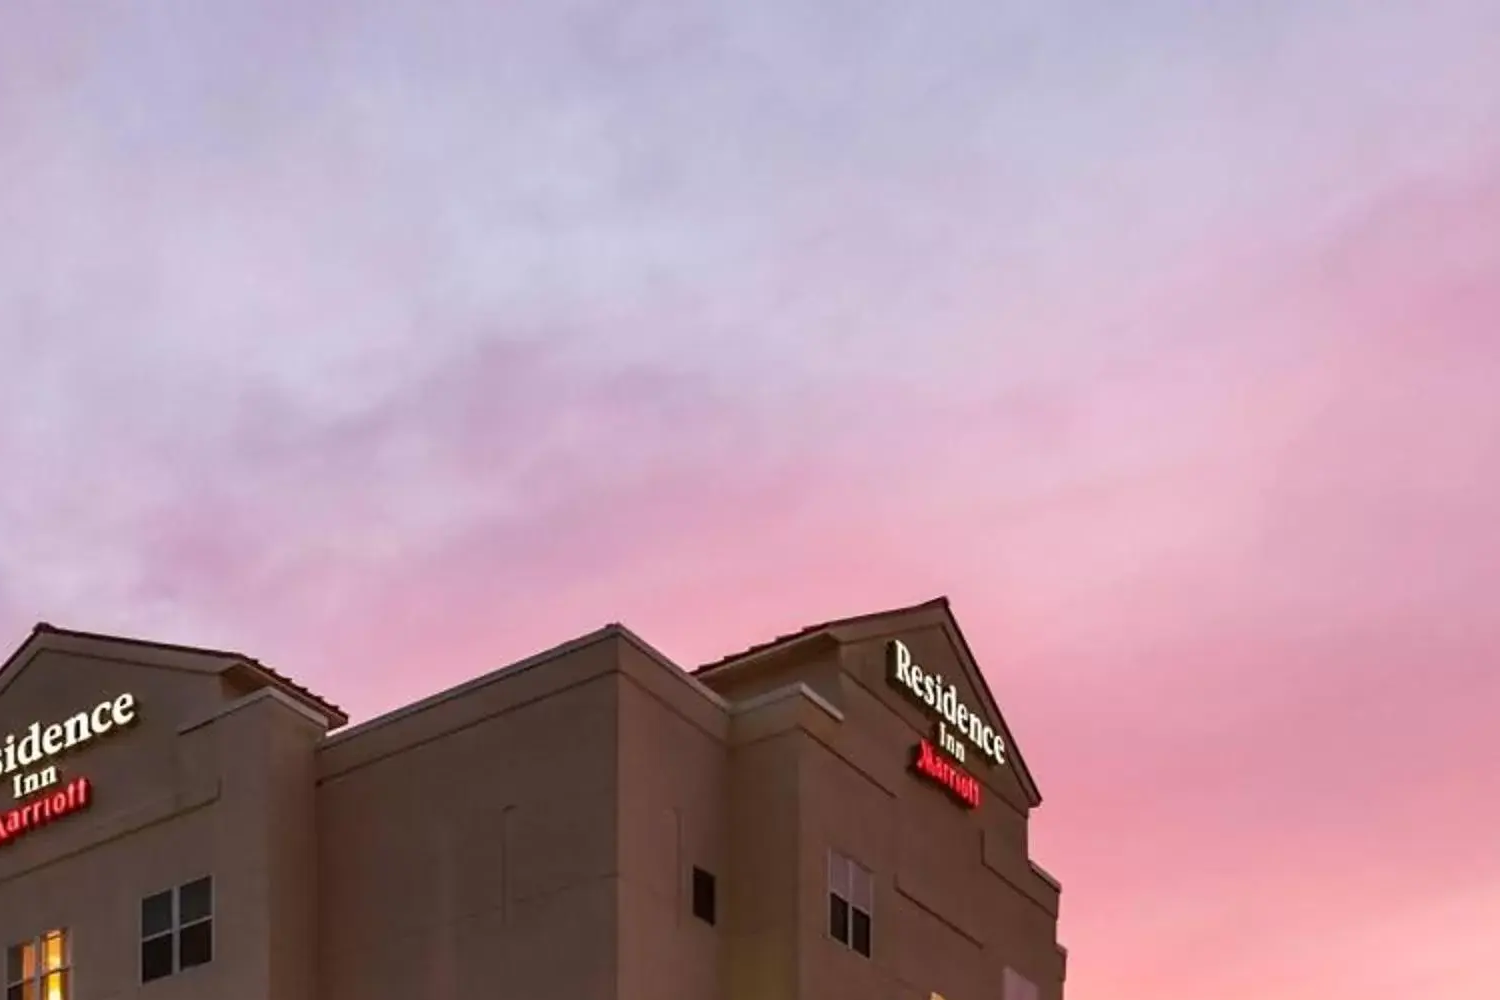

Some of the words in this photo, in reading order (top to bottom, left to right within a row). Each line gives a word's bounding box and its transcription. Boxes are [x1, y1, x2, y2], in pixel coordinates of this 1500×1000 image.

[894, 639, 1006, 764] Residence
[939, 721, 965, 763] Inn
[12, 765, 58, 799] Inn
[916, 738, 981, 807] Marriott
